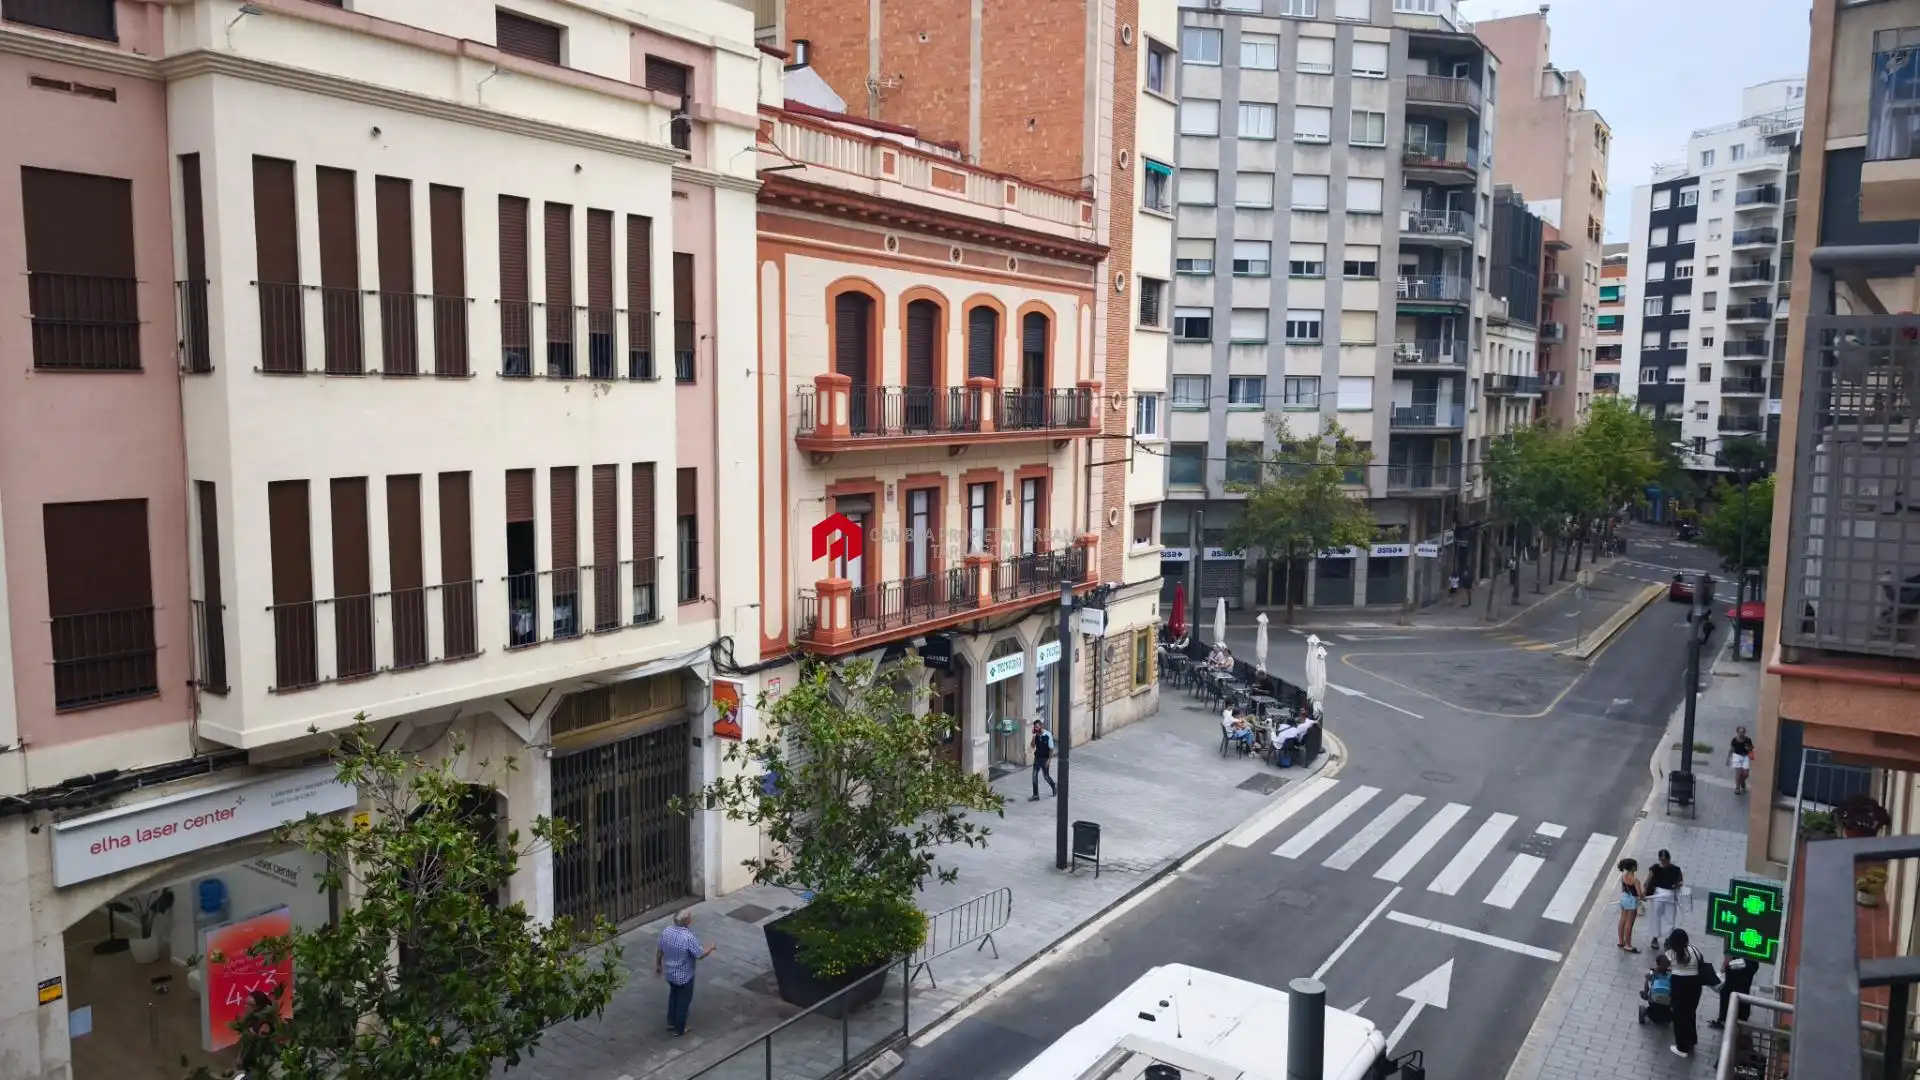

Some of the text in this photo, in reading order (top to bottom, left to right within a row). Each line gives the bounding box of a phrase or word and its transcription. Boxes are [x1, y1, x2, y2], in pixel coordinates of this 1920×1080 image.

[1377, 546, 1398, 554] asisa
[90, 806, 238, 855] elha laser center
